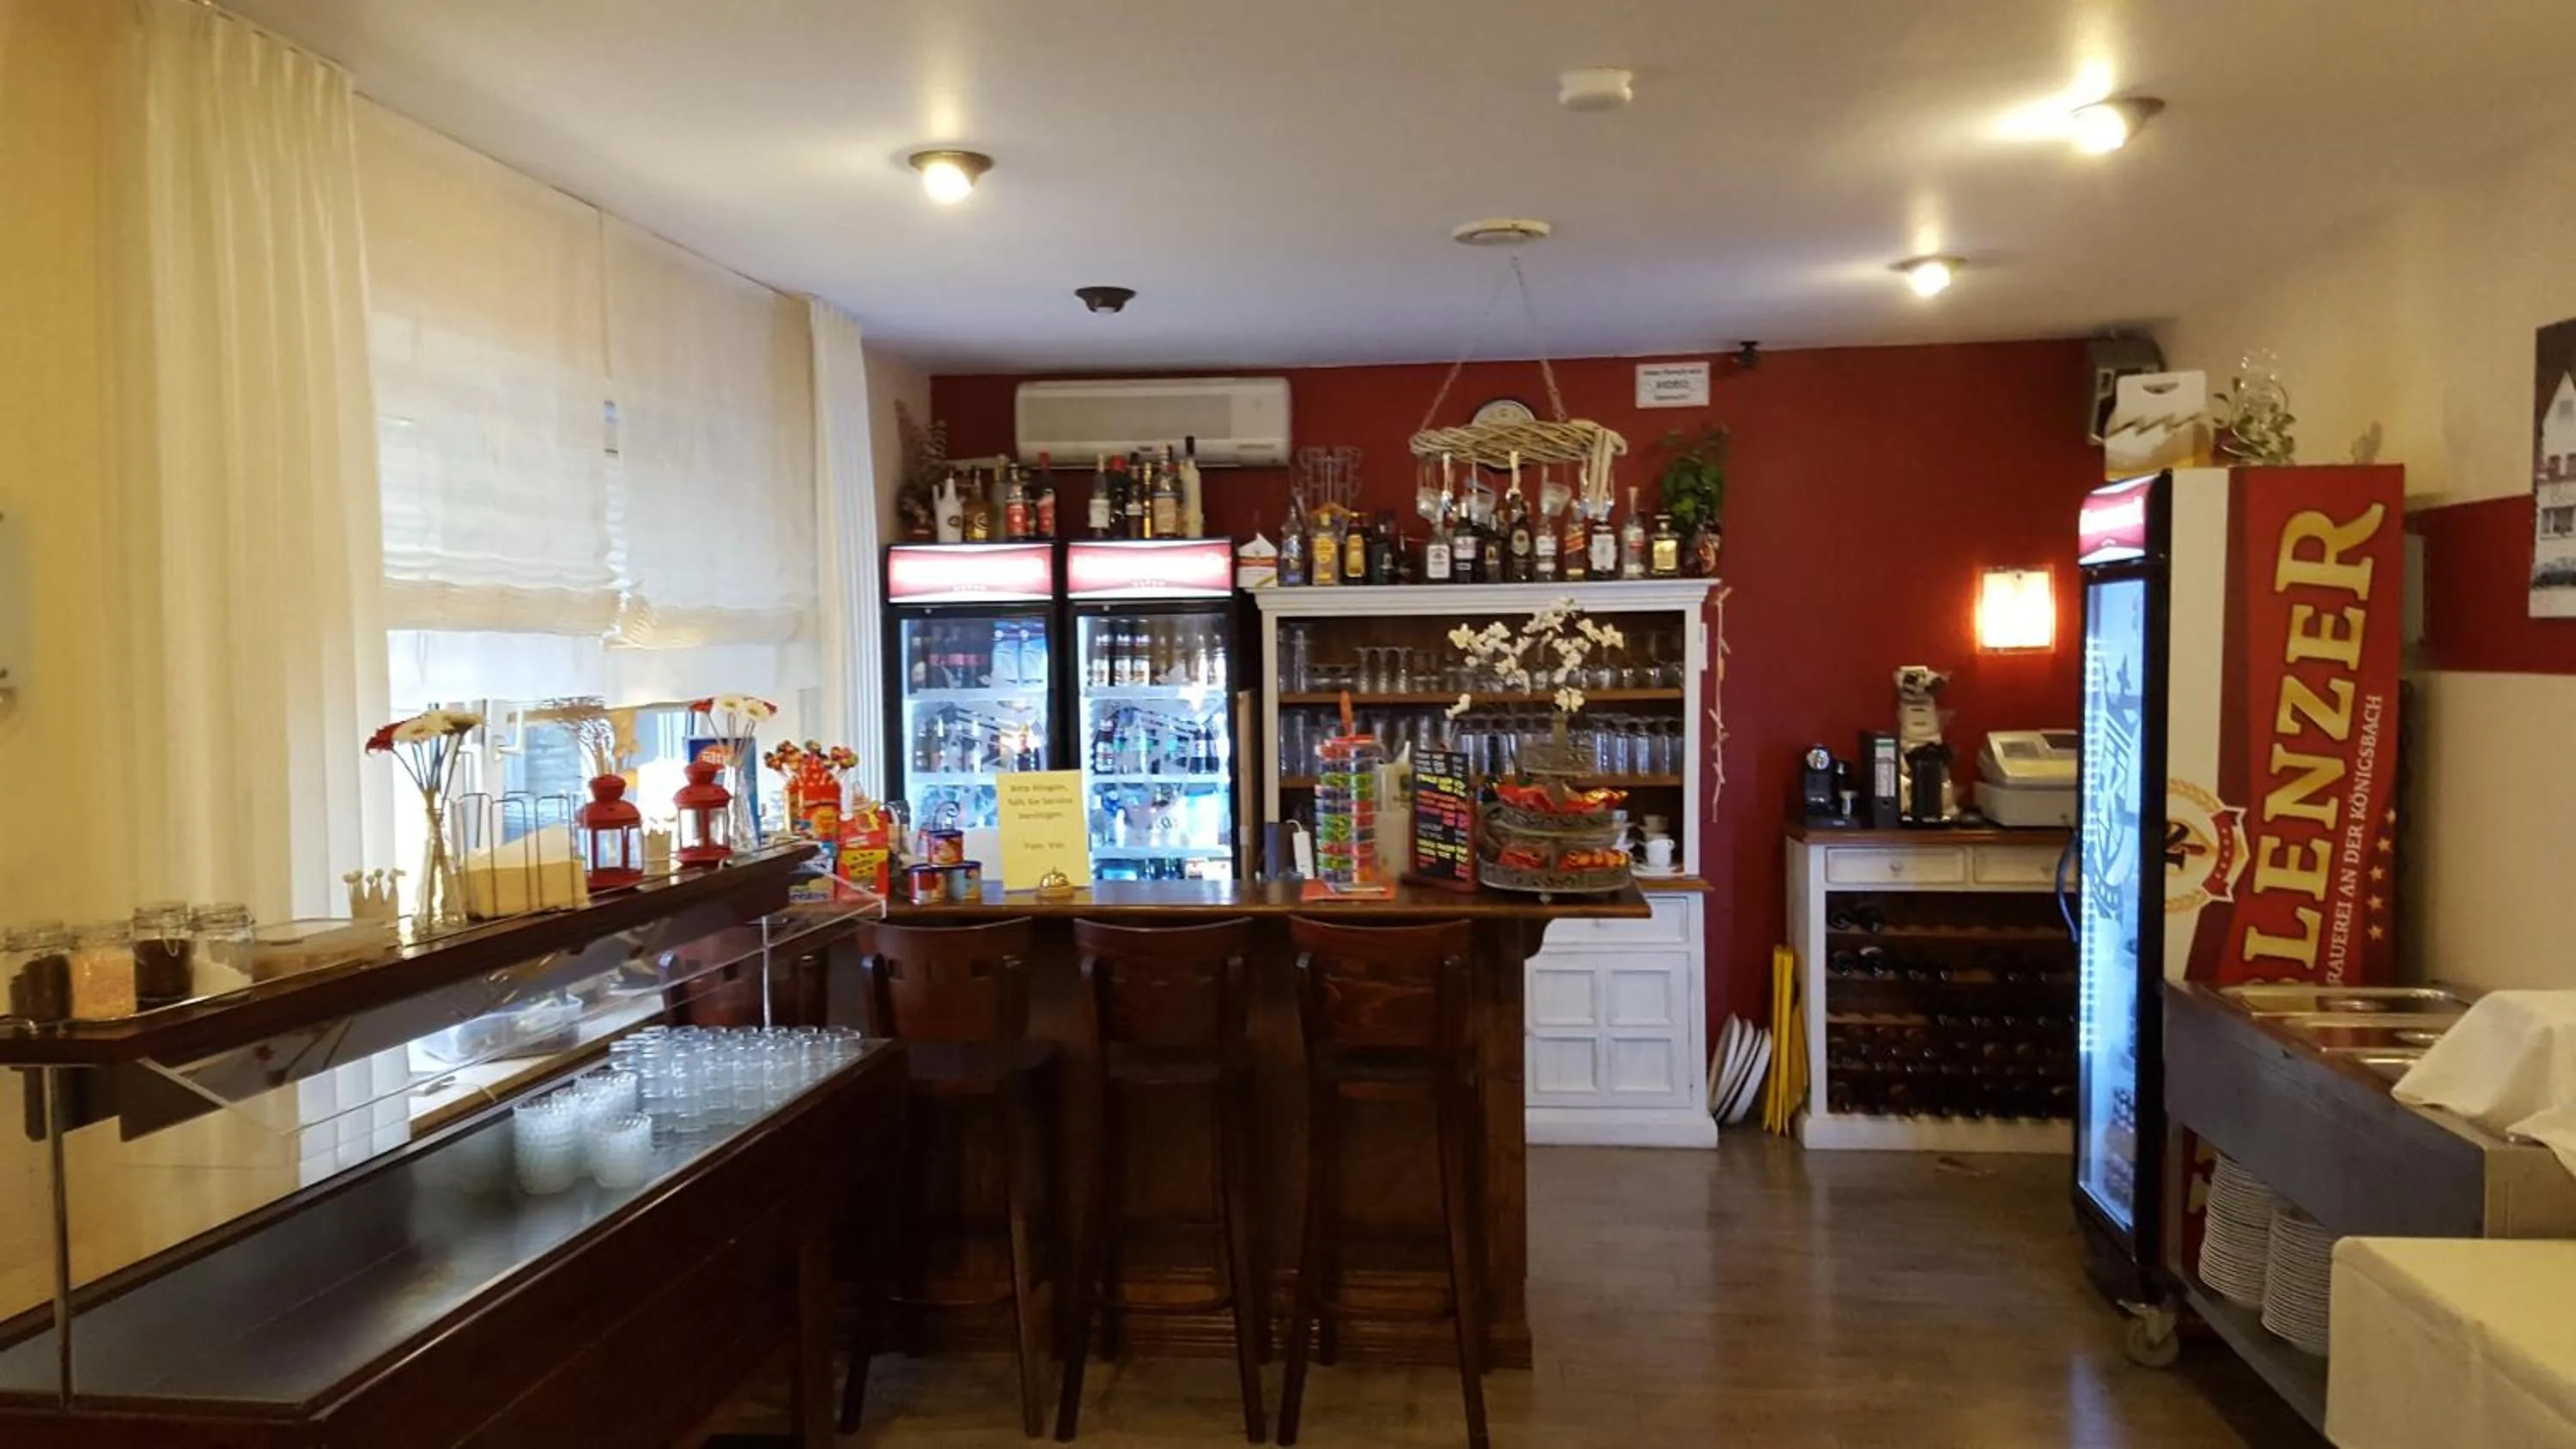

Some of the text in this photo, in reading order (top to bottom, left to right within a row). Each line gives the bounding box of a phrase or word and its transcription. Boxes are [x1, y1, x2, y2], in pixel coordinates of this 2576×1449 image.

[2243, 503, 2385, 984] LENZER
[2326, 694, 2384, 986] RAUEREI AN DER KÖNIGSBACH
